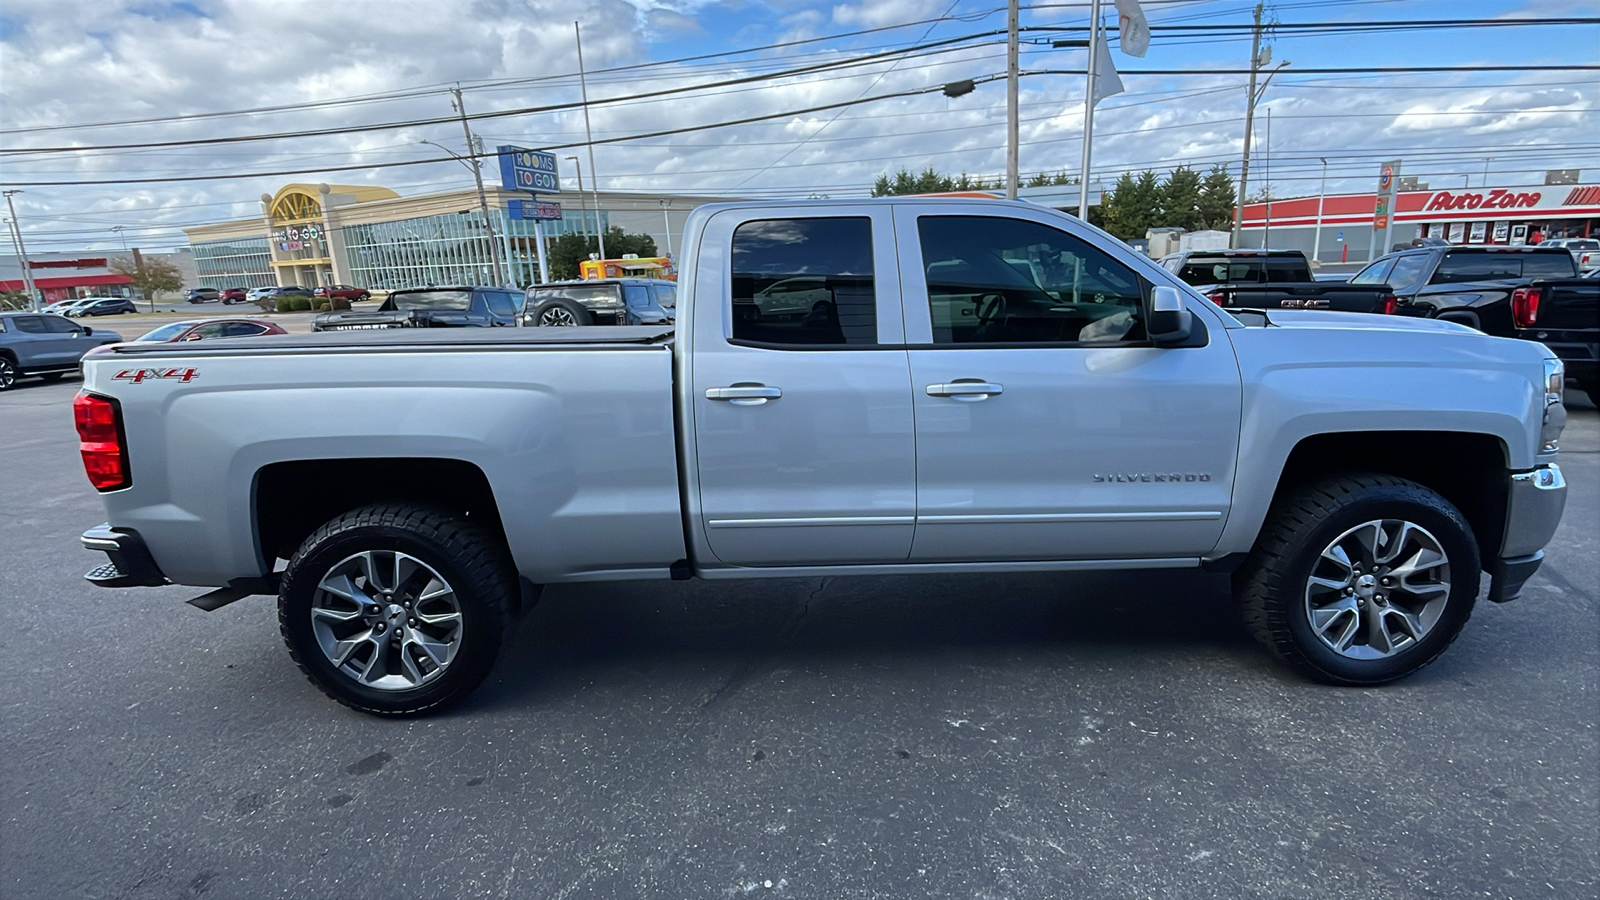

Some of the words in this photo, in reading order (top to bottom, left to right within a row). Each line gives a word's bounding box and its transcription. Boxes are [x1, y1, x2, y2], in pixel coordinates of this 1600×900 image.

[517, 153, 553, 170] ROOMS
[519, 171, 532, 185] TO
[535, 173, 550, 187] GO
[538, 203, 560, 218] KIDS
[1281, 299, 1330, 309] GMC
[1093, 473, 1211, 483] SILVERADO
